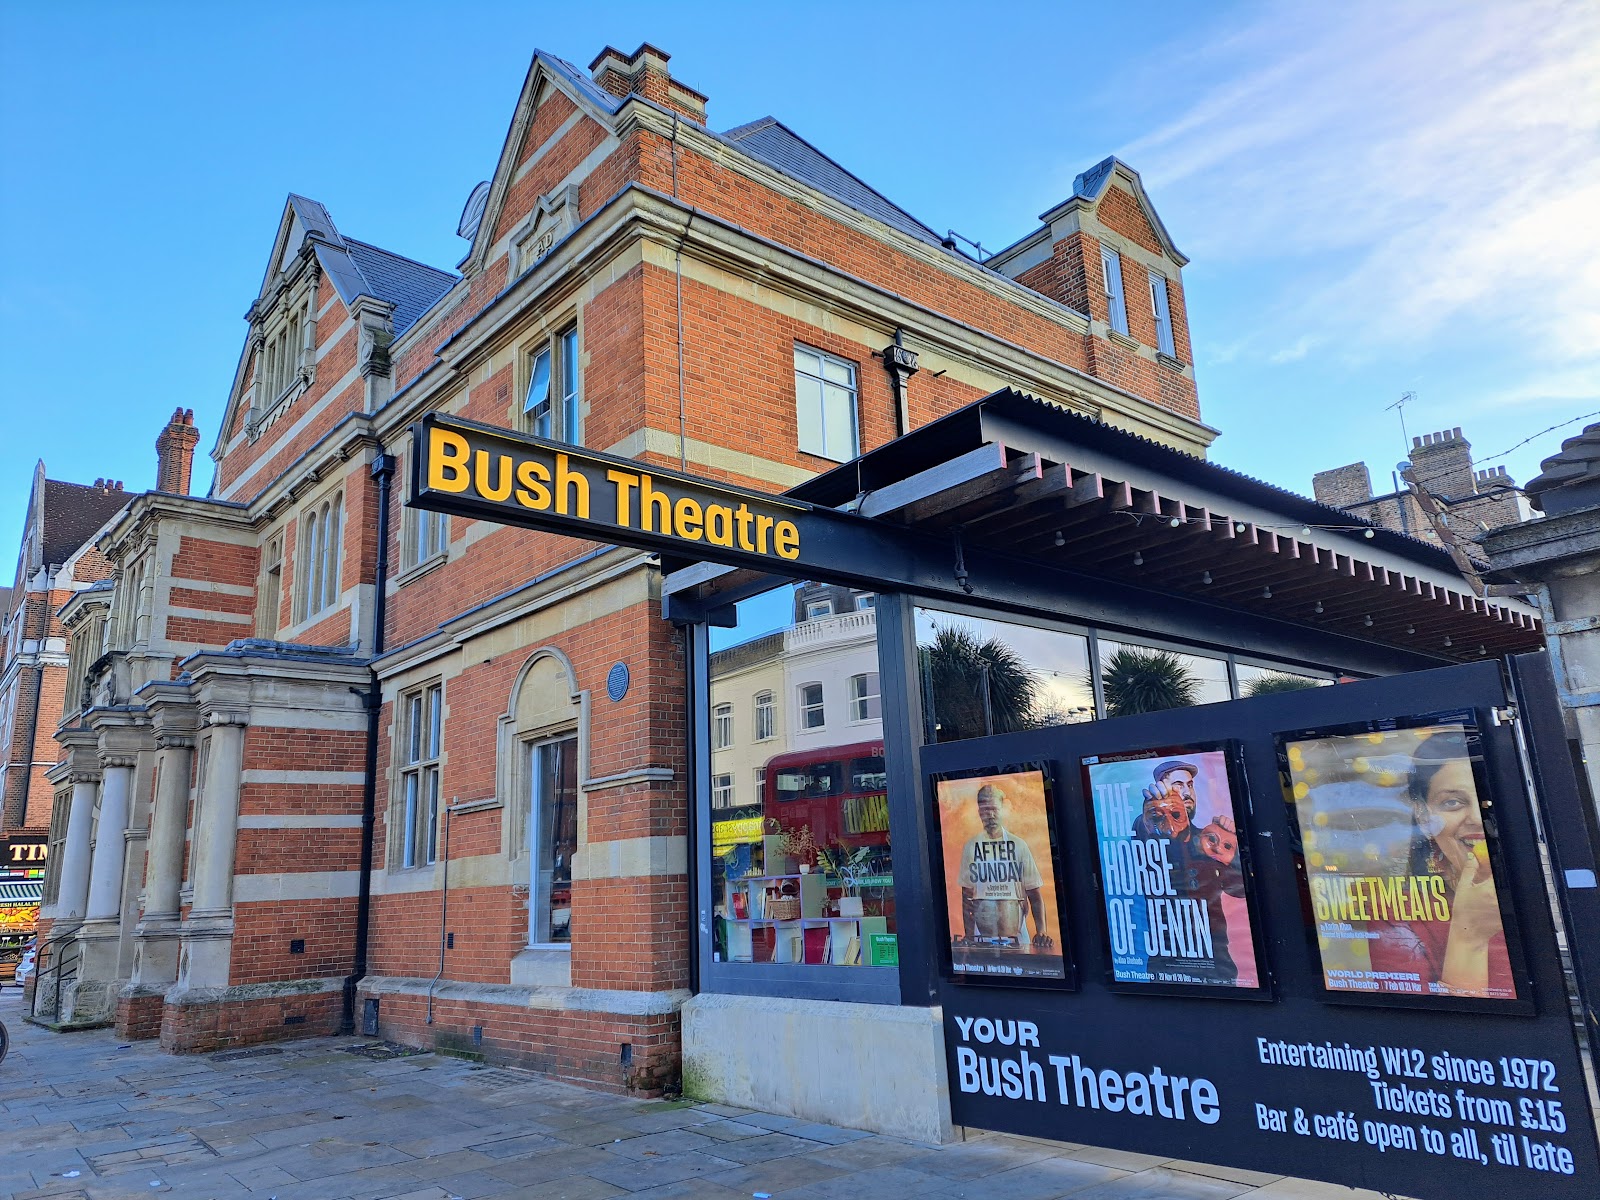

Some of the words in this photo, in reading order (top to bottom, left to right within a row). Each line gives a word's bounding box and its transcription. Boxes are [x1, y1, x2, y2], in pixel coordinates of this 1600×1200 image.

[428, 427, 590, 519] Bush
[607, 470, 800, 560] Theatre
[1096, 783, 1137, 838] THE
[969, 862, 1024, 883] SUNDAY
[974, 841, 1016, 862] AFTER
[1102, 839, 1177, 896] HORSE
[1312, 875, 1450, 922] SWEETMEATS
[1109, 898, 1138, 957] OF
[1143, 898, 1214, 959] JENIN
[1115, 969, 1131, 979] Bush
[1131, 971, 1155, 981] Theatre
[1327, 970, 1364, 978] WORLD
[1365, 972, 1420, 981] PREMIERE
[1328, 978, 1348, 988] Bush
[1348, 979, 1379, 990] Theatre
[954, 1016, 1040, 1048] YOUR
[956, 1046, 1047, 1102] Bush
[1048, 1054, 1220, 1124] Theatre
[1256, 1037, 1380, 1079] Entertaining
[1380, 1046, 1428, 1079] W12
[1433, 1051, 1496, 1086] since
[1499, 1056, 1560, 1092] 1972
[1370, 1081, 1452, 1119] Tickets
[1455, 1089, 1514, 1127] from
[1520, 1098, 1567, 1134] £15
[1255, 1102, 1287, 1133] Bar
[1293, 1107, 1310, 1136] &
[1314, 1112, 1360, 1143] café
[1364, 1120, 1417, 1152] open
[1420, 1124, 1446, 1155] to
[1450, 1127, 1488, 1165] all,
[1491, 1133, 1520, 1168] til
[1523, 1135, 1575, 1175] late
